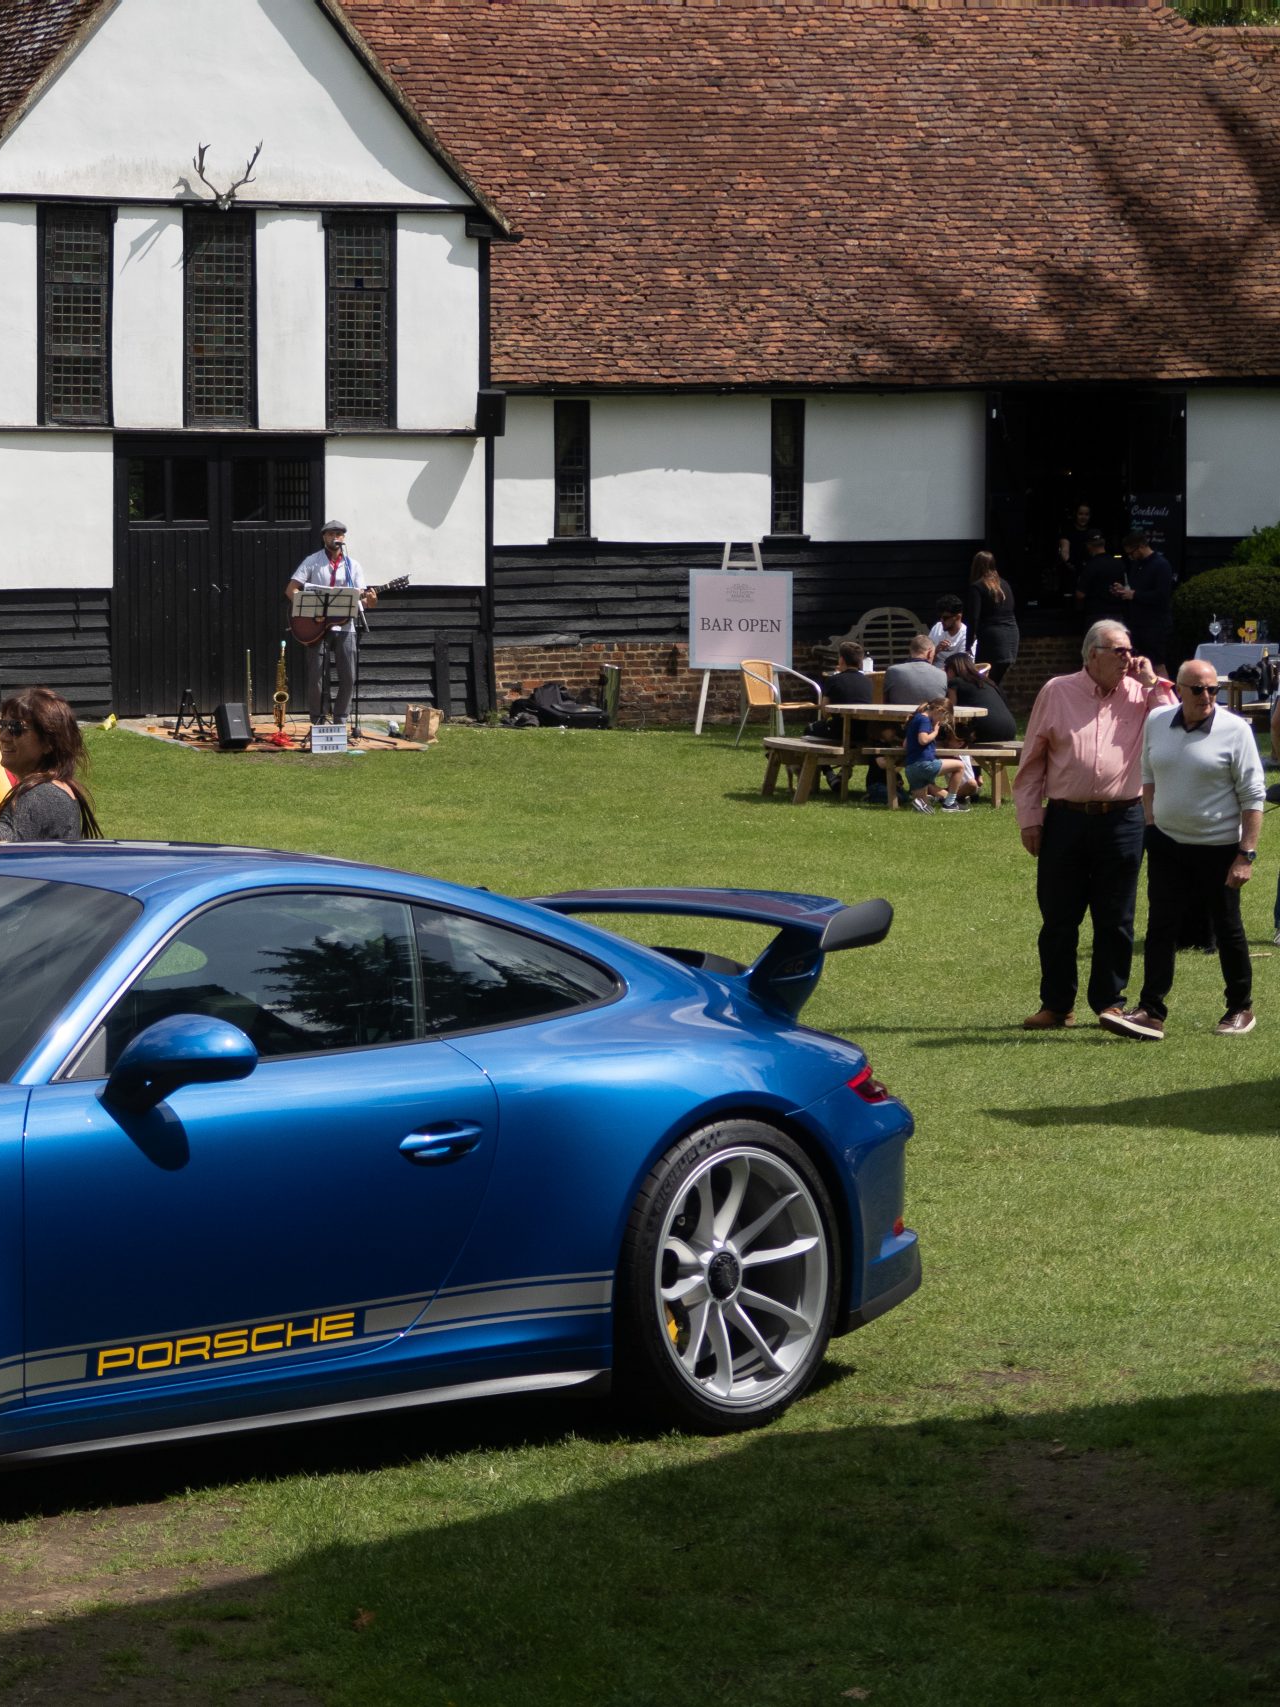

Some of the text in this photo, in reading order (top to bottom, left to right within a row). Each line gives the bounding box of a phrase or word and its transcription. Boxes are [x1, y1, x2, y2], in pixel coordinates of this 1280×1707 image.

[700, 617, 782, 633] BAR OPEN
[97, 1312, 355, 1377] PORSCHE
